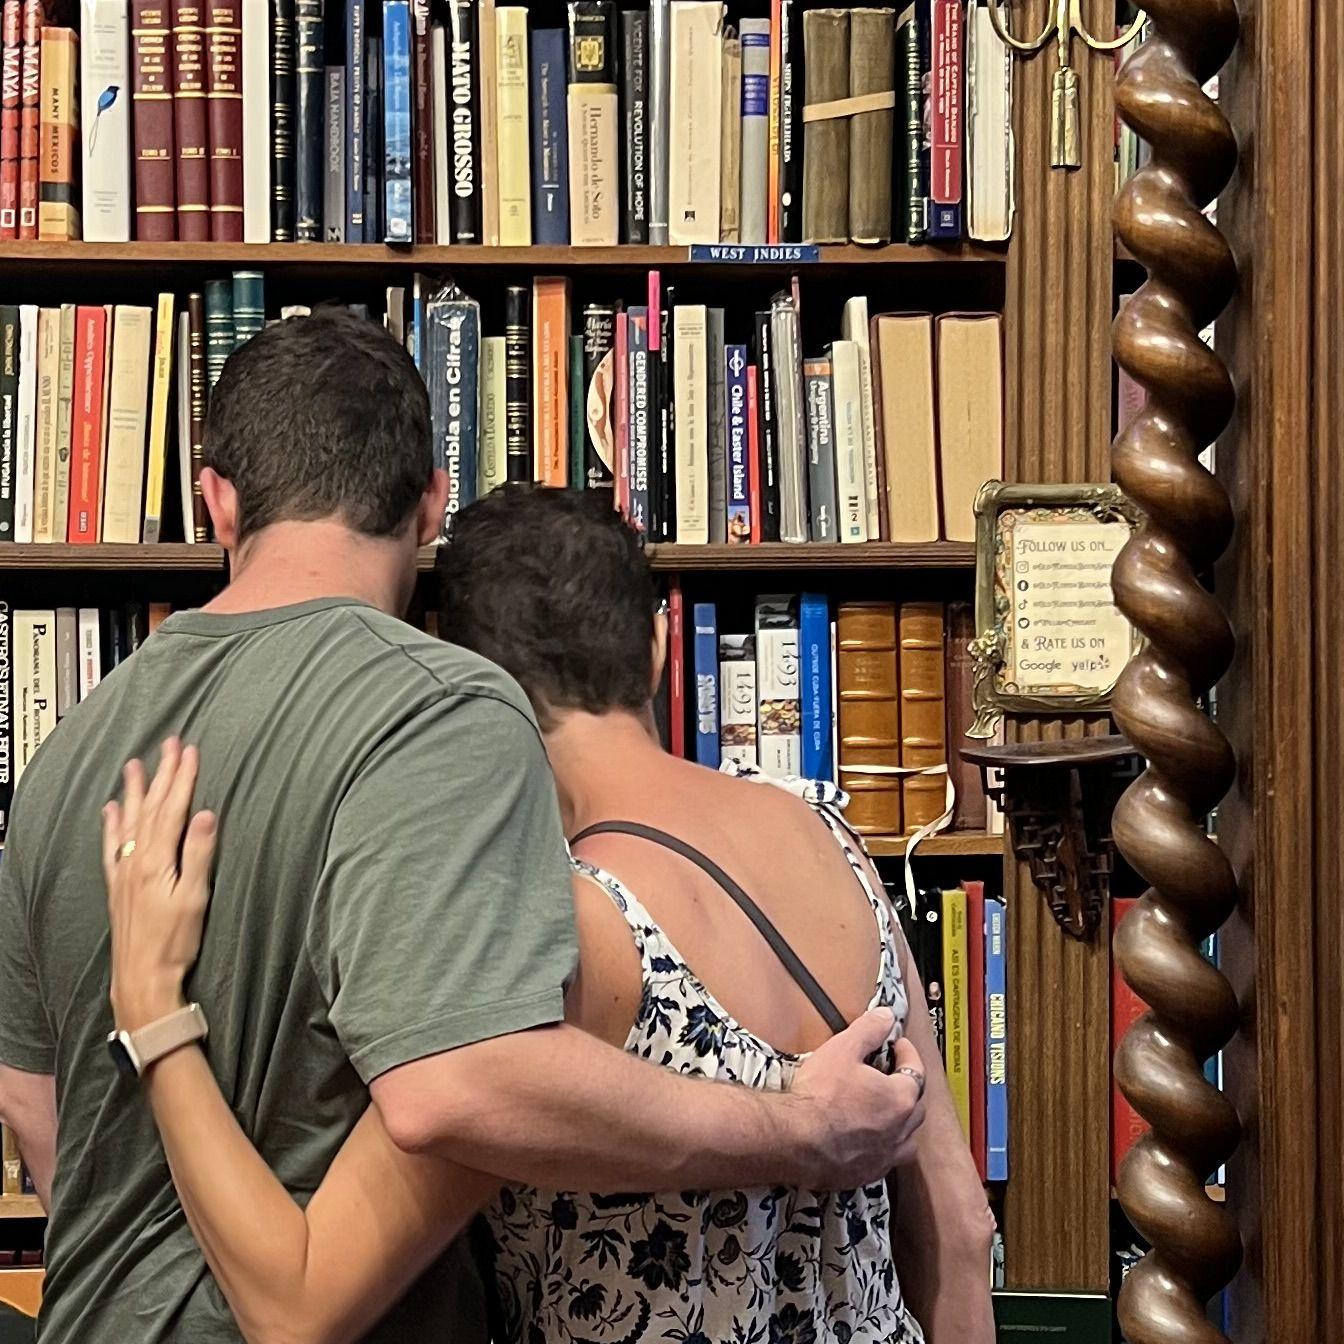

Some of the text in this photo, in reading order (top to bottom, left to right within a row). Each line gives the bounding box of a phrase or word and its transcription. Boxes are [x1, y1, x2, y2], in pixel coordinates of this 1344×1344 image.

[2, 46, 19, 100] MAYA
[22, 45, 39, 100] MAYA
[452, 41, 473, 198] MATO GROSSO
[589, 106, 603, 219] Hernando de Soto
[710, 247, 801, 260] WEST INDIES
[445, 387, 461, 418] en
[635, 350, 647, 492] GENDERED COMPROMISES
[816, 380, 830, 445] Argentina
[1016, 539, 1066, 555] FOLLOW
[1071, 541, 1086, 552] US
[776, 642, 801, 687] 1493
[1019, 658, 1063, 674] Google
[1021, 638, 1029, 649] &
[1071, 638, 1086, 649] US
[1090, 638, 1105, 649] ON
[1071, 658, 1099, 673] yelp
[732, 673, 754, 715] 1493
[989, 993, 1006, 1085] CHICANO VISIONS
